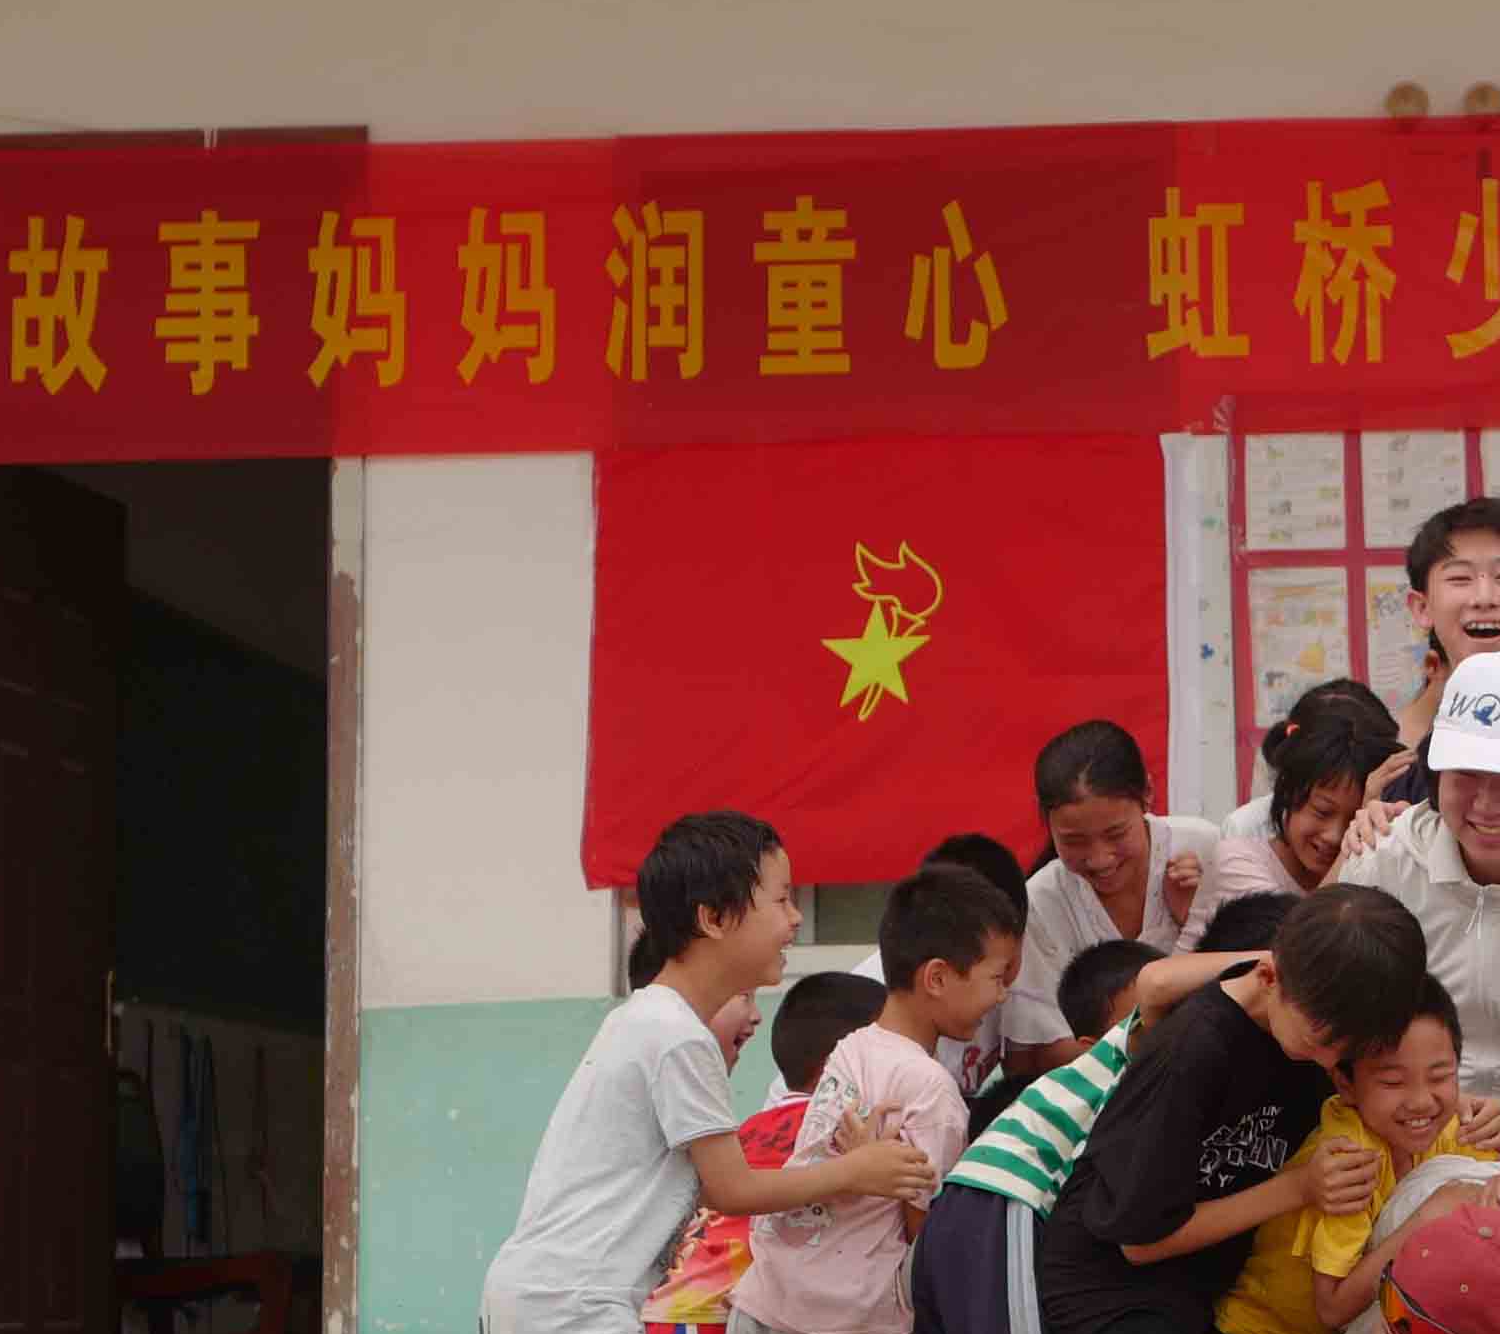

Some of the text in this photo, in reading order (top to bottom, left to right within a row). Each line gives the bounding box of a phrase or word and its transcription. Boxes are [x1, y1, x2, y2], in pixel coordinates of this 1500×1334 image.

[9, 197, 1008, 395] 故事妈妈润童心
